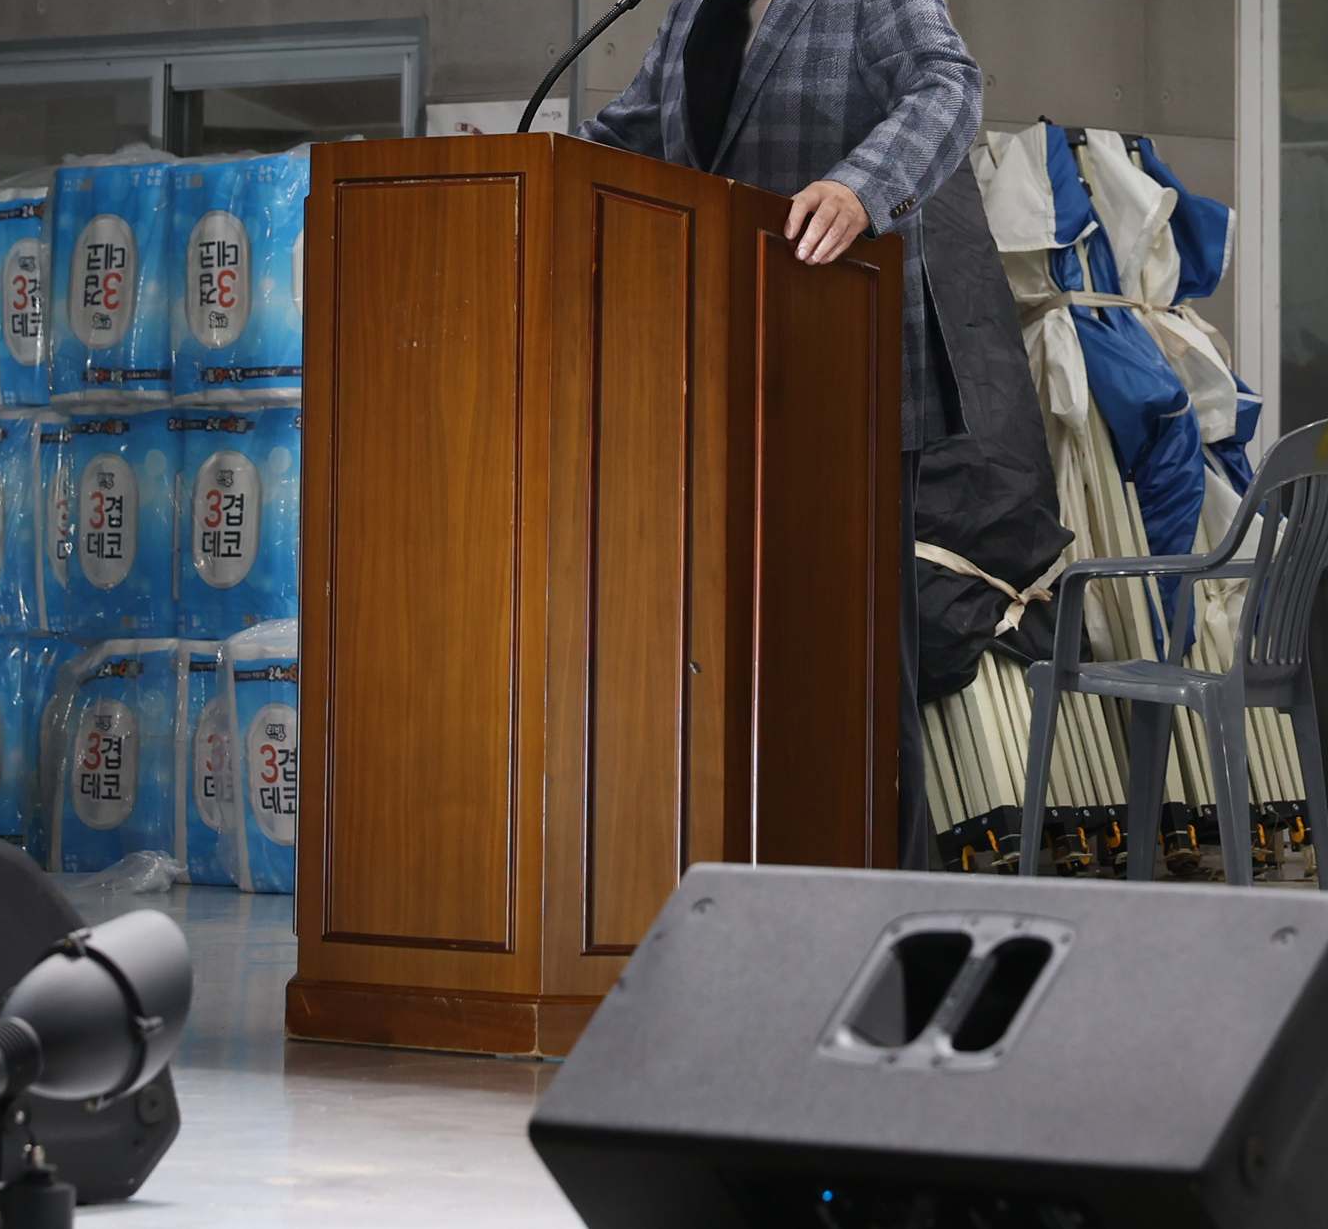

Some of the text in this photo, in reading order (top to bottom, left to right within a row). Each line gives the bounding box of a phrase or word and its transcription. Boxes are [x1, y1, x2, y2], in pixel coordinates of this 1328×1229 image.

[87, 243, 126, 271] 데코
[199, 240, 239, 269] 데코
[83, 273, 122, 310] 3겹
[199, 270, 237, 308] 3겹
[89, 492, 123, 529] 3겹
[204, 489, 244, 527] 3겹
[87, 532, 122, 559] 데코
[202, 531, 242, 558] 데코
[266, 724, 285, 741] 리빙
[83, 733, 122, 770] 3겹
[80, 774, 121, 800] 데코
